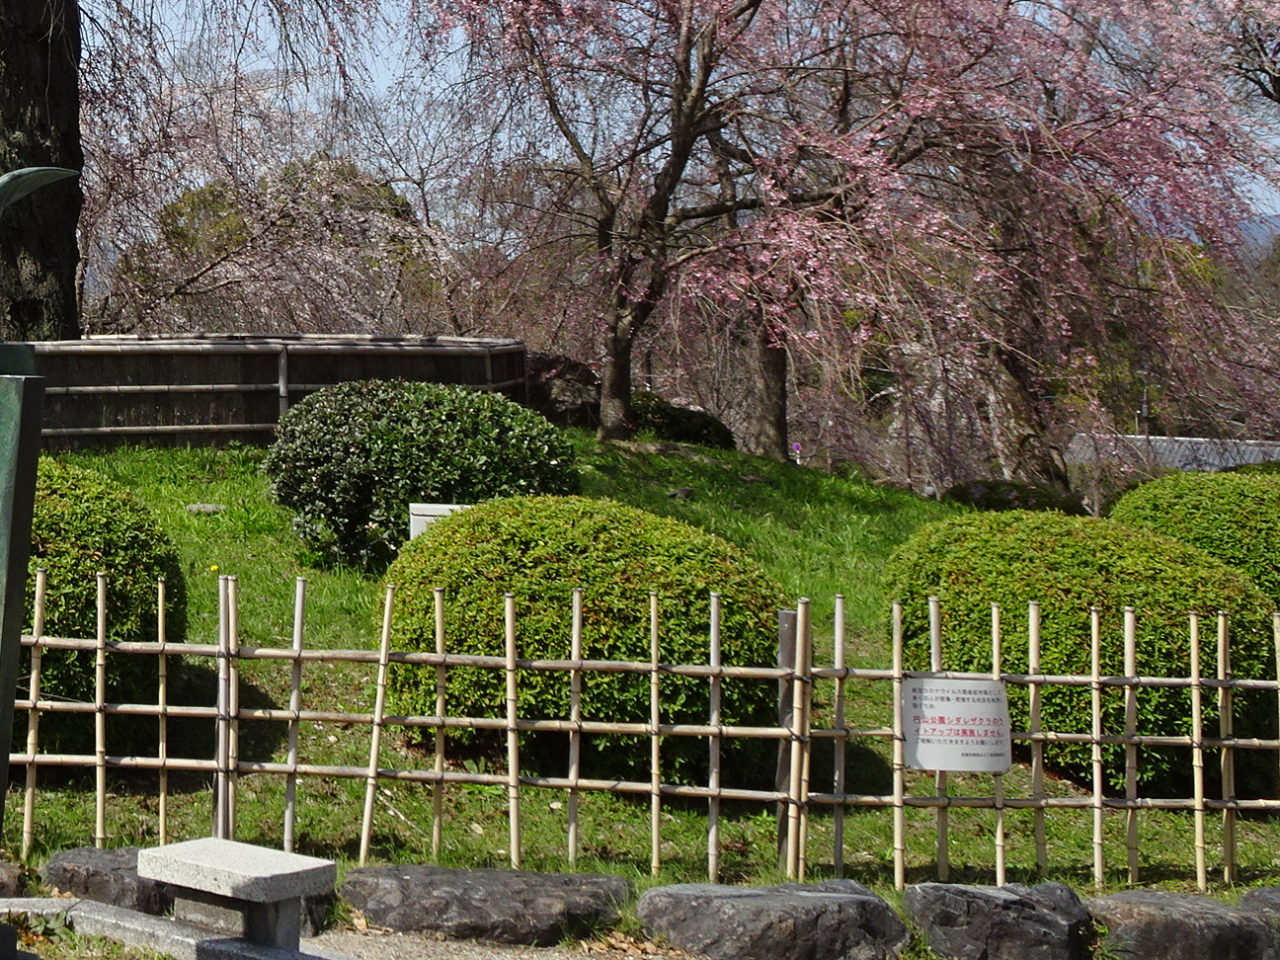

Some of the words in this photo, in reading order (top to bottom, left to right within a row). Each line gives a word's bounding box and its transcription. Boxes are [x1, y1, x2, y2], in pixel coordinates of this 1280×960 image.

[913, 715, 1003, 725] 円山公園シダレザクラのラ
[914, 728, 1004, 738] イトアップは実施しません。
